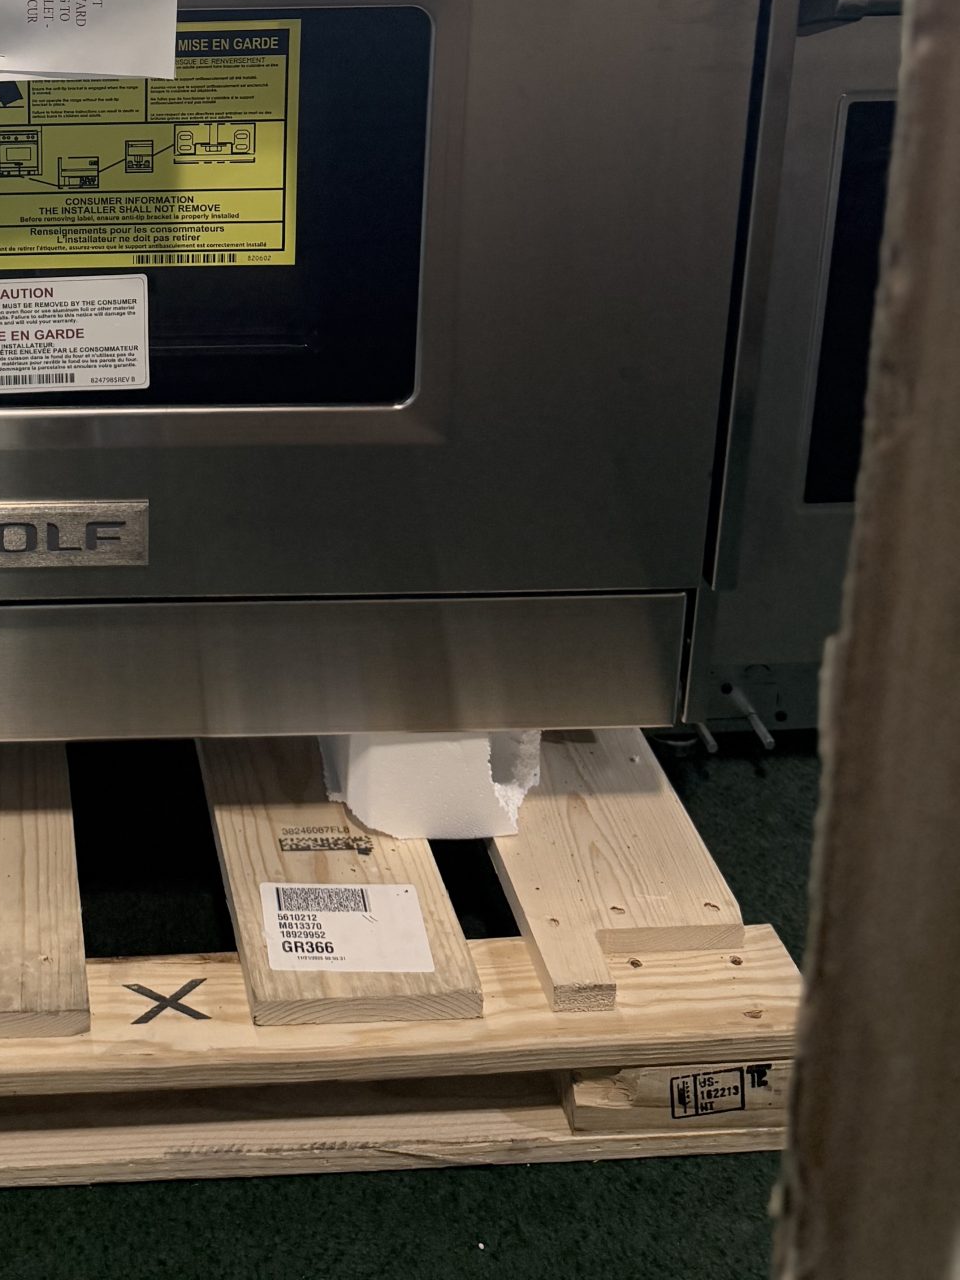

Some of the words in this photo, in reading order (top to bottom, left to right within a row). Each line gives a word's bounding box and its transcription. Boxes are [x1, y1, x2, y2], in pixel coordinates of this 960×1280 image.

[59, 5, 70, 22] TO
[177, 38, 209, 52] MISE
[211, 37, 230, 51] EN
[232, 36, 279, 51] GARDE
[64, 197, 122, 206] CONSUMER
[124, 196, 194, 205] INFORMATION
[38, 206, 58, 215] THE
[60, 205, 116, 215] INSTALLER
[118, 205, 151, 214] SHALL
[153, 204, 176, 214] NOT
[177, 204, 220, 213] REMOVE
[29, 226, 108, 237] Renseignements
[109, 226, 132, 236] pour
[133, 226, 147, 235] les
[148, 225, 225, 235] consommateurs
[56, 234, 117, 244] L'installateur
[118, 234, 130, 243] ne
[132, 234, 150, 243] doit
[152, 234, 170, 242] pas
[171, 233, 201, 242] retirer
[33, 301, 69, 309] REMOVED
[96, 298, 137, 306] CONSUMER
[9, 330, 30, 342] EN
[33, 328, 85, 341] GARDE
[276, 913, 318, 922] 5610212
[277, 922, 323, 931] M813370
[279, 930, 327, 939] 18929952
[280, 941, 335, 954] GR366
